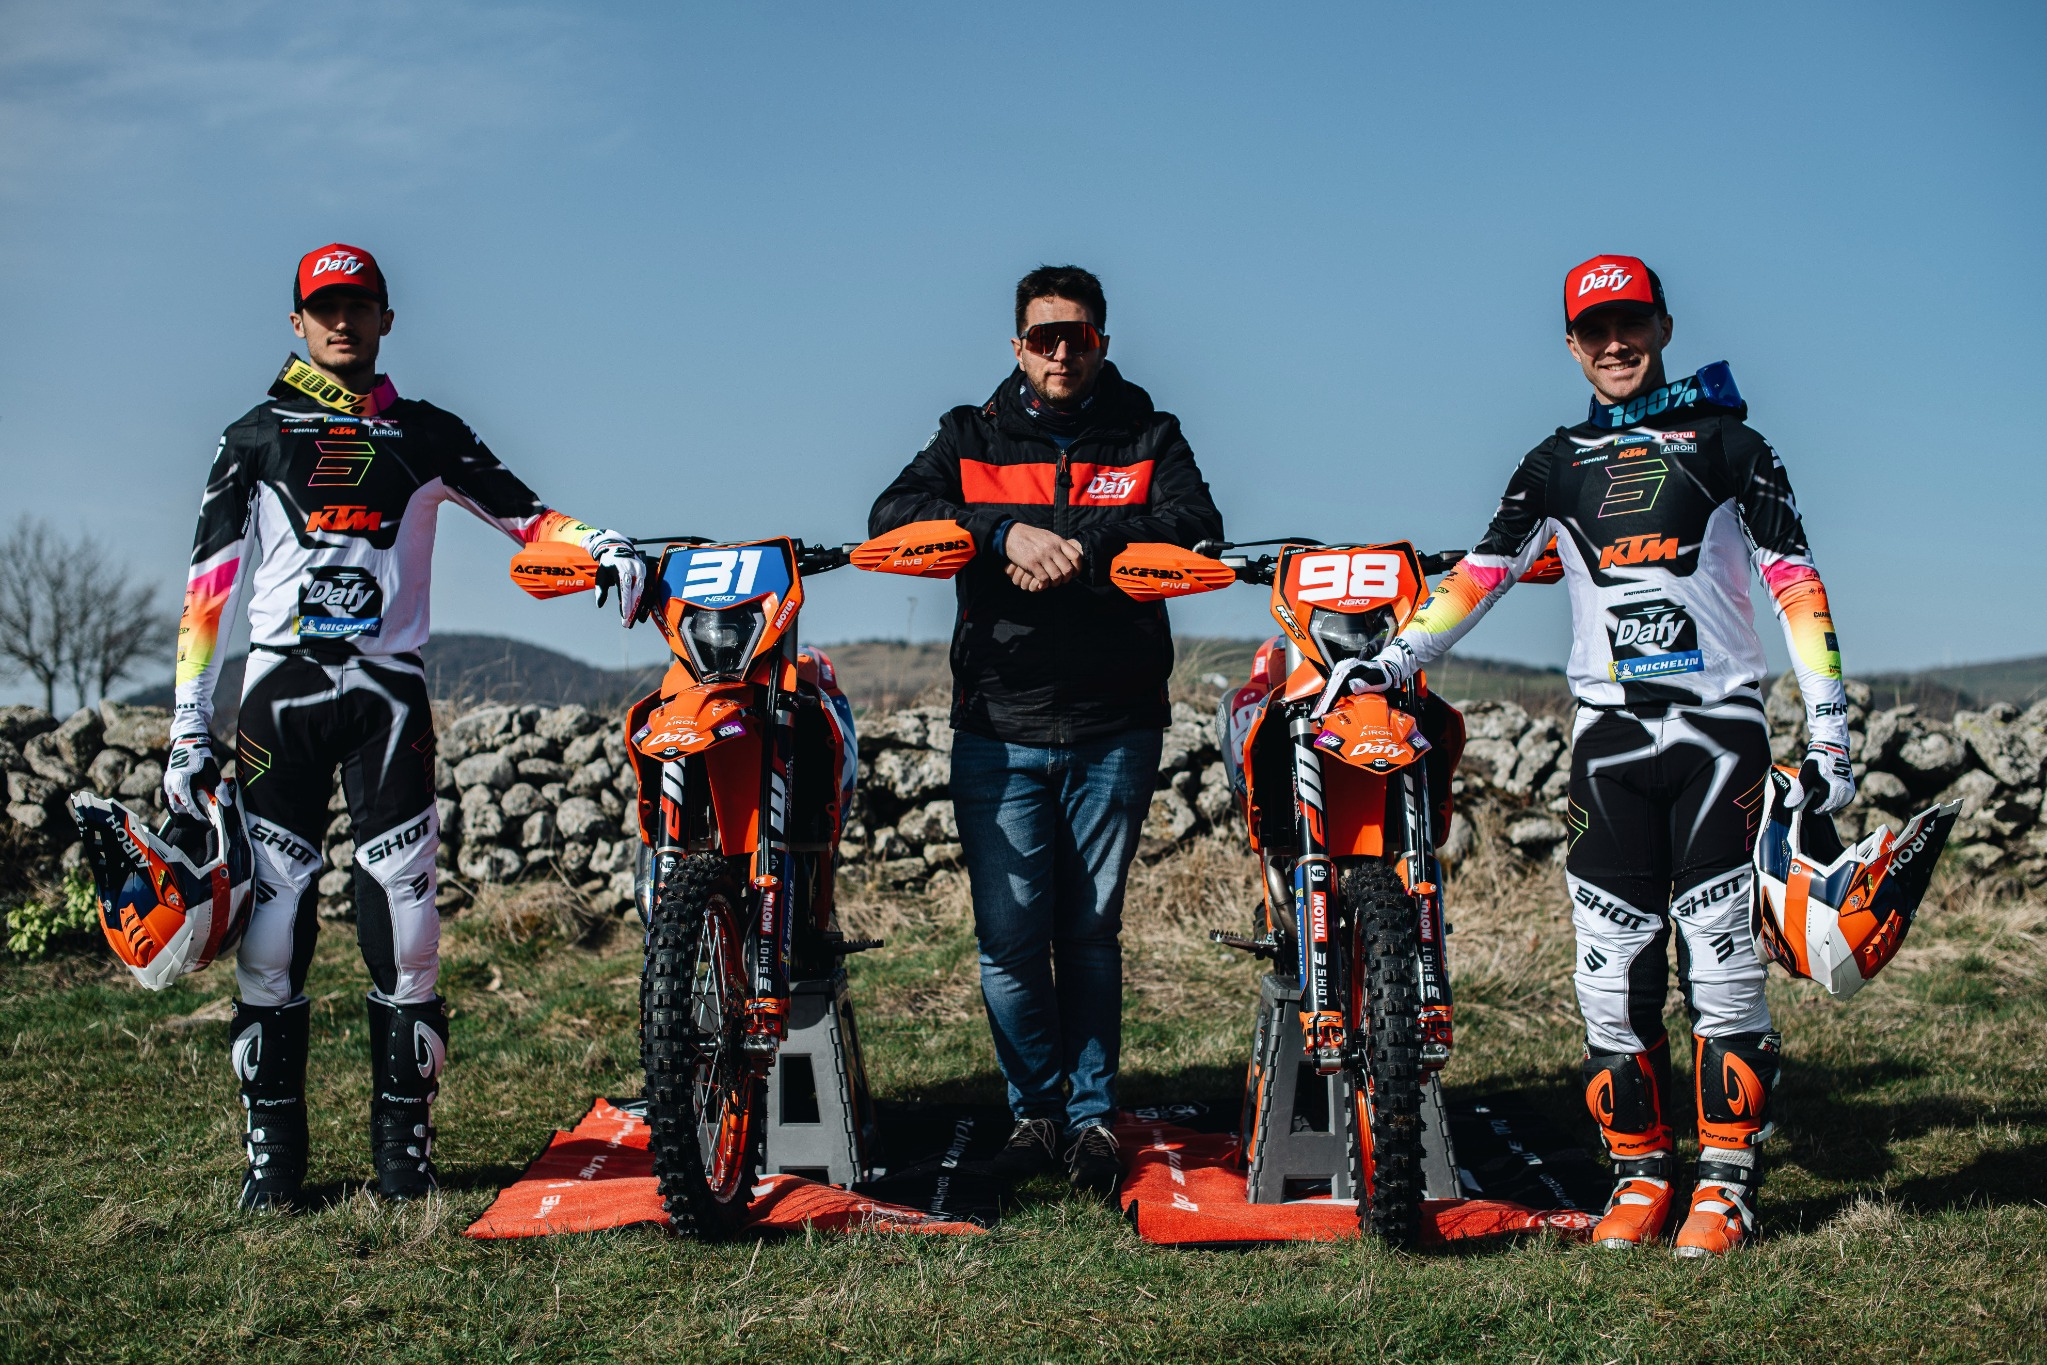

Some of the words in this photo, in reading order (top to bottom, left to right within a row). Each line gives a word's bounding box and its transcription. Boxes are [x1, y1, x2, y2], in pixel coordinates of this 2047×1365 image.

[312, 255, 364, 278] Dafy
[1578, 269, 1632, 297] Dafy
[288, 365, 367, 414] 100%
[1608, 378, 1697, 427] 100%
[328, 426, 356, 435] KTM
[372, 428, 400, 436] AIROH
[1618, 447, 1647, 459] KTM
[1663, 444, 1694, 452] AIROH
[1087, 476, 1136, 498] Dafy
[305, 505, 382, 532] KTM
[901, 540, 970, 557] ACERBIS
[1599, 533, 1679, 569] KTM
[513, 564, 576, 576] ACERBIS
[682, 550, 762, 598] 31
[1116, 566, 1183, 580] ACERBIS
[1298, 553, 1400, 601] 98
[304, 580, 375, 613] Dafy
[319, 622, 378, 632] MICHELIN
[775, 600, 797, 629] MOTUL
[1614, 612, 1687, 648] Dafy
[1634, 657, 1699, 673] MICHELIN
[646, 732, 705, 747] Dafy
[664, 720, 698, 728] AIROH
[719, 724, 742, 737] KTM
[1349, 743, 1406, 758] Dafy
[1771, 771, 1789, 791] AIROH
[106, 814, 153, 869] AIROH
[250, 822, 318, 866] SHOT
[367, 815, 431, 865] SHOT
[1885, 820, 1936, 876] AIROH
[1574, 885, 1649, 930] SHOT
[1677, 873, 1745, 917] SHOT
[762, 891, 774, 933] MOTUL
[1313, 893, 1326, 940] MOTUL
[1420, 898, 1432, 940] MOTUL
[760, 939, 769, 974] SHOT
[1422, 946, 1435, 982] SHOT
[1317, 968, 1328, 1005] SHOT
